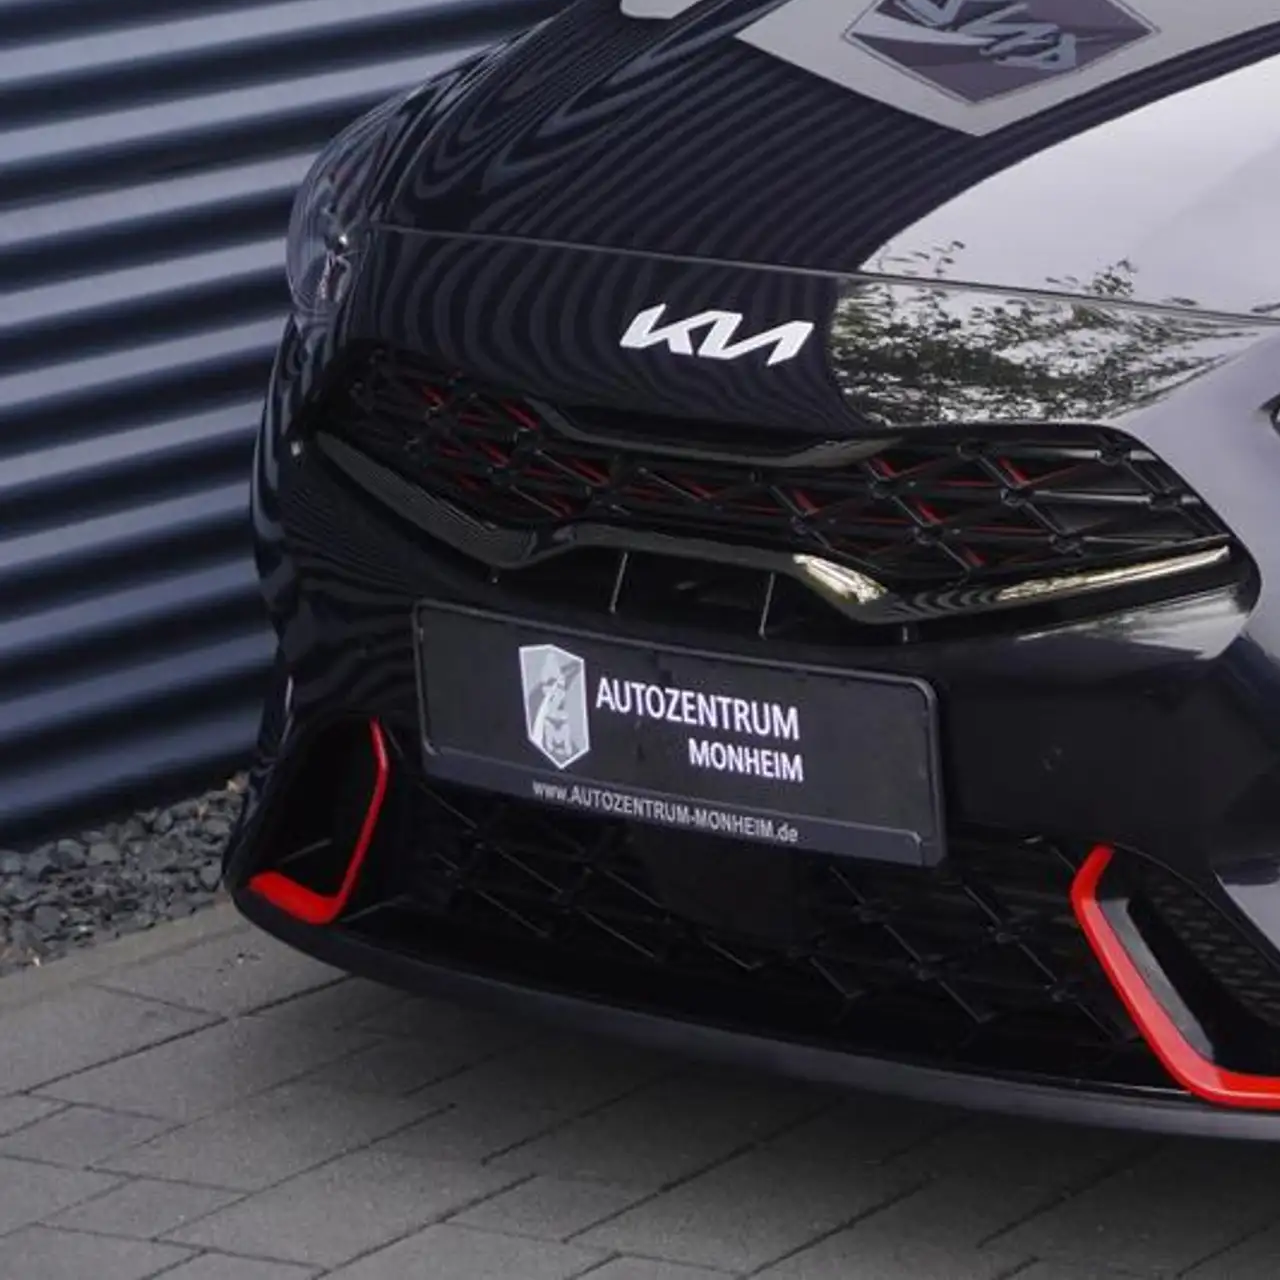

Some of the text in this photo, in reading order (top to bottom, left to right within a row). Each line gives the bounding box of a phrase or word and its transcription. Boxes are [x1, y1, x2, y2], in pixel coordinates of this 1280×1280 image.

[619, 303, 815, 367] KIA
[596, 676, 800, 742] AUTOZENTRUM
[688, 737, 804, 784] MONHEIM
[532, 780, 799, 843] www.AUTOZENTRUM-MONHEIM.de
